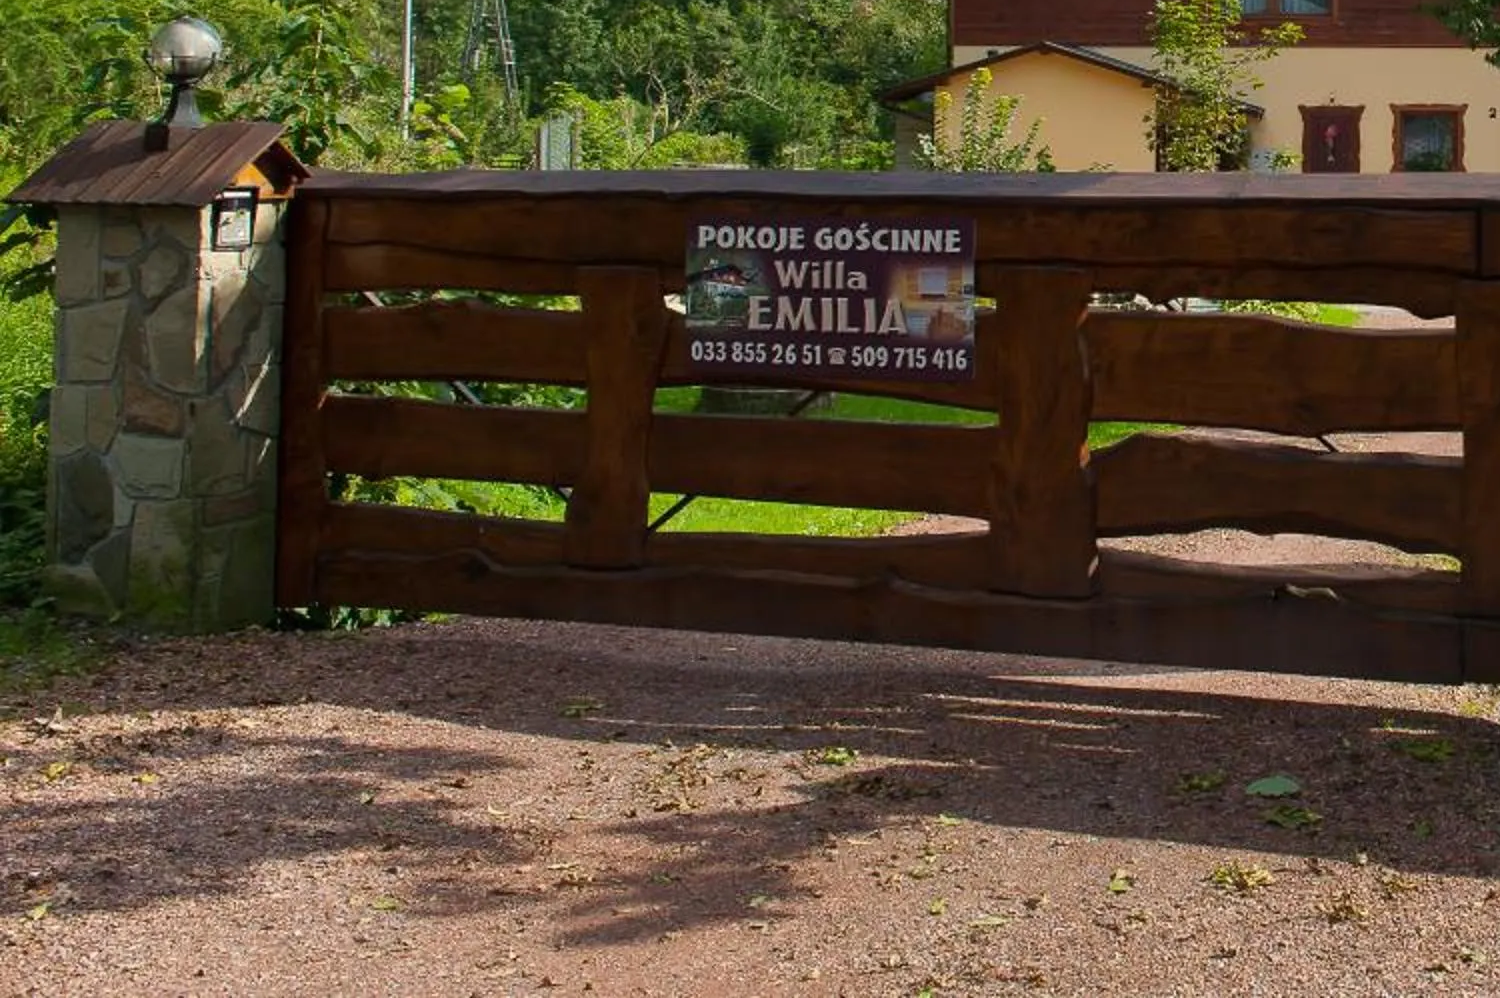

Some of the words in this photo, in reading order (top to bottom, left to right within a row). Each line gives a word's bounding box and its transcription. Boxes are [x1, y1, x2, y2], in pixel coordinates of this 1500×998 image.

[698, 225, 805, 252] POKOJE
[814, 222, 961, 253] GOŚCINNE
[774, 259, 867, 290] Willa
[747, 295, 908, 335] EMILIA
[691, 341, 727, 363] 033
[732, 342, 767, 364] 855
[771, 343, 797, 365] 26
[801, 345, 822, 366] 51
[851, 346, 888, 368] 509
[895, 347, 927, 369] 715
[932, 349, 968, 371] 416
